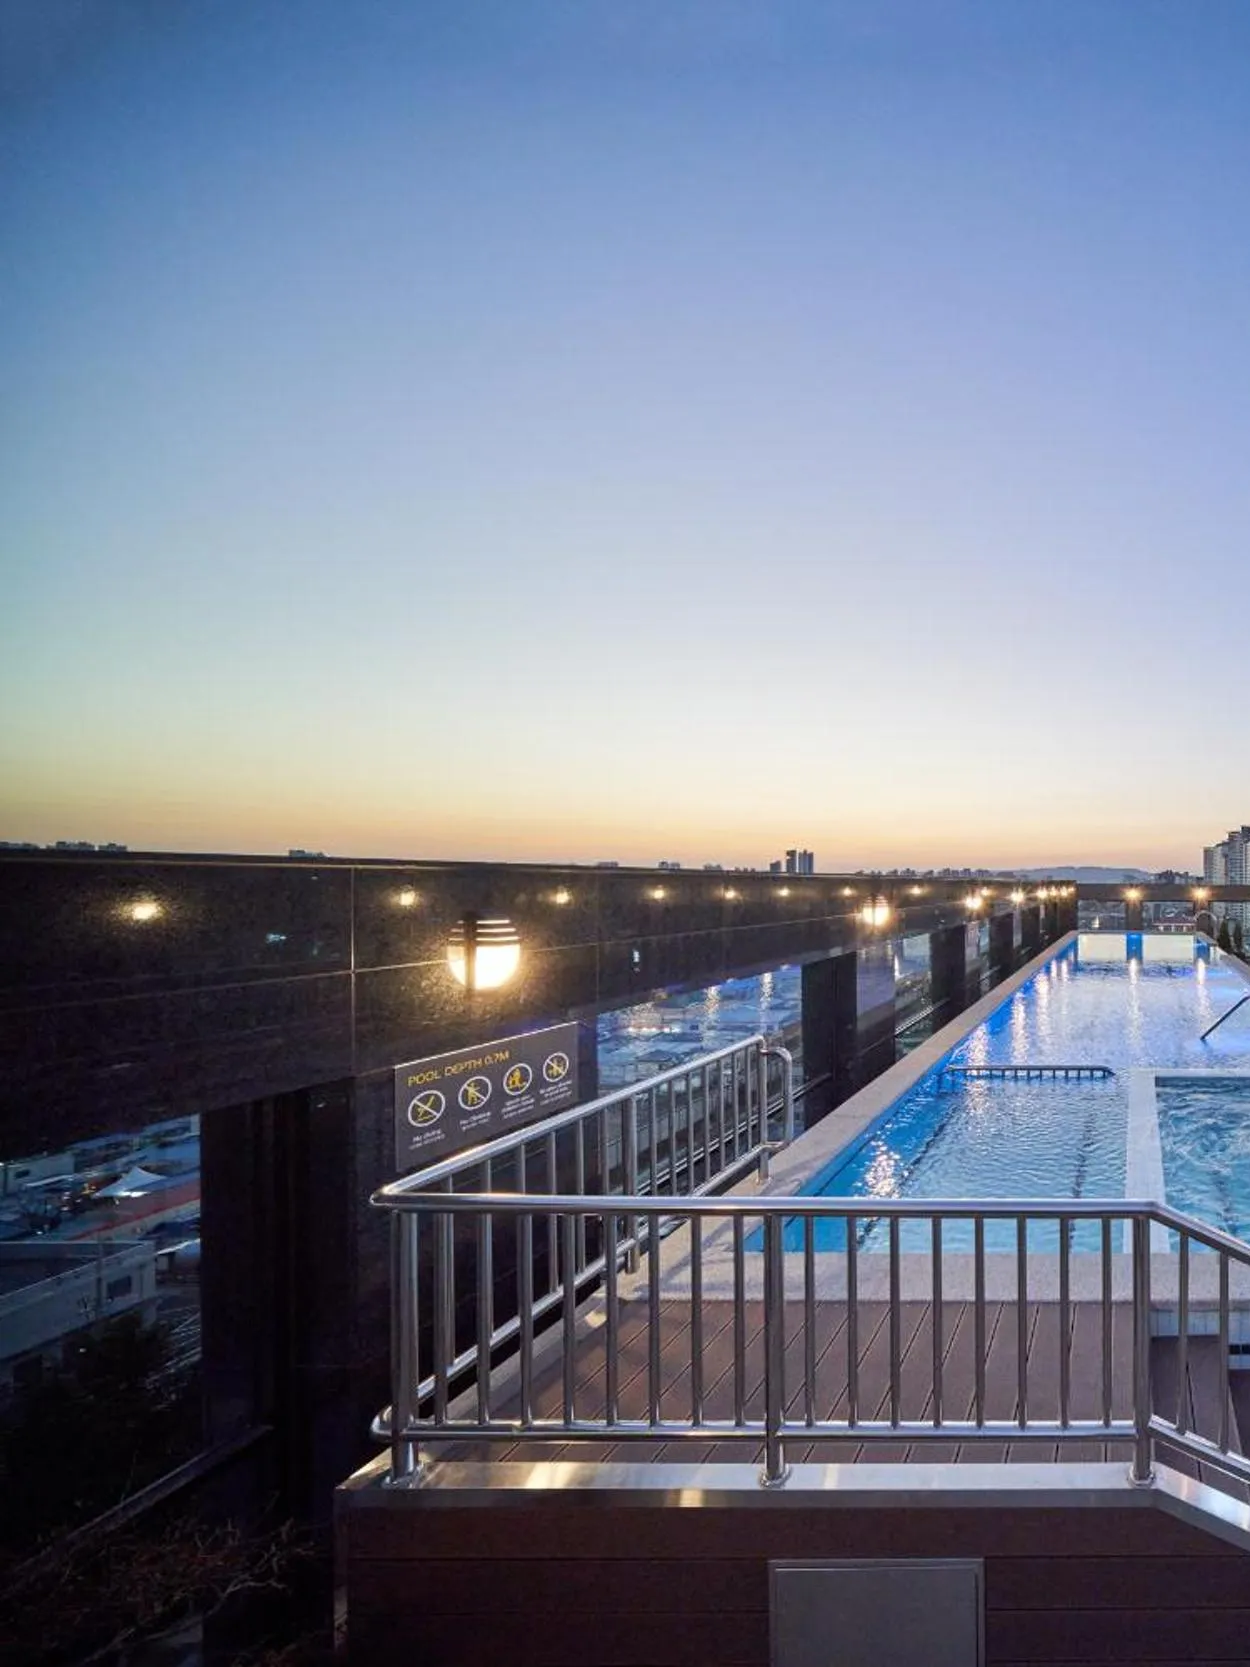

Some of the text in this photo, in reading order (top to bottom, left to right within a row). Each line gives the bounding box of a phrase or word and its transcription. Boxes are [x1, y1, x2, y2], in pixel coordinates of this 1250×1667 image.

[408, 1050, 510, 1087] POOL DEPTH 0.7M
